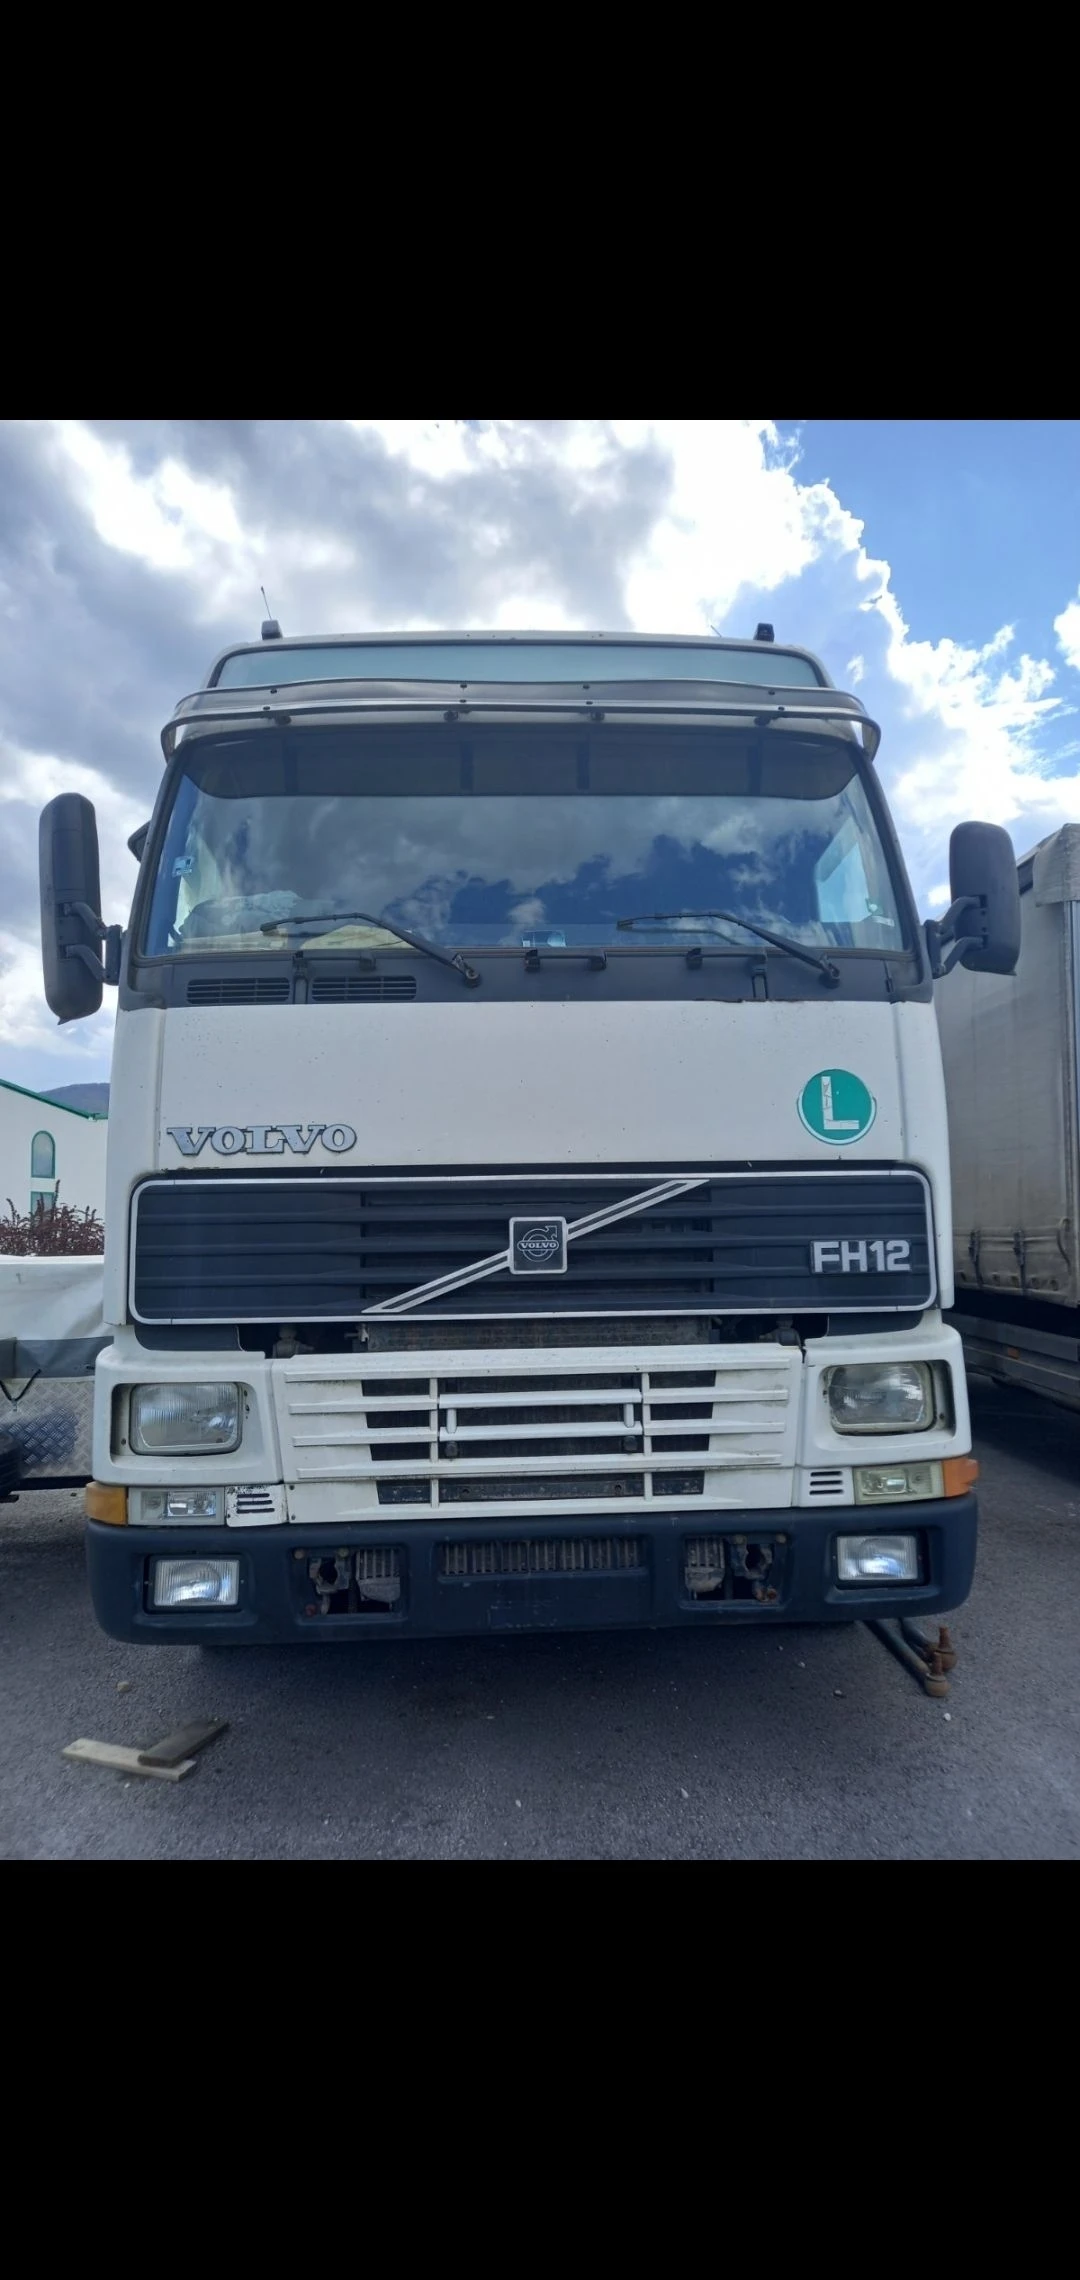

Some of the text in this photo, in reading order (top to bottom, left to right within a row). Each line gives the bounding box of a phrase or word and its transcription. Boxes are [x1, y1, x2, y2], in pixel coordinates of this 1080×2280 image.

[821, 1076, 860, 1130] L
[167, 1124, 357, 1156] VOLVO
[813, 1240, 911, 1273] FH12
